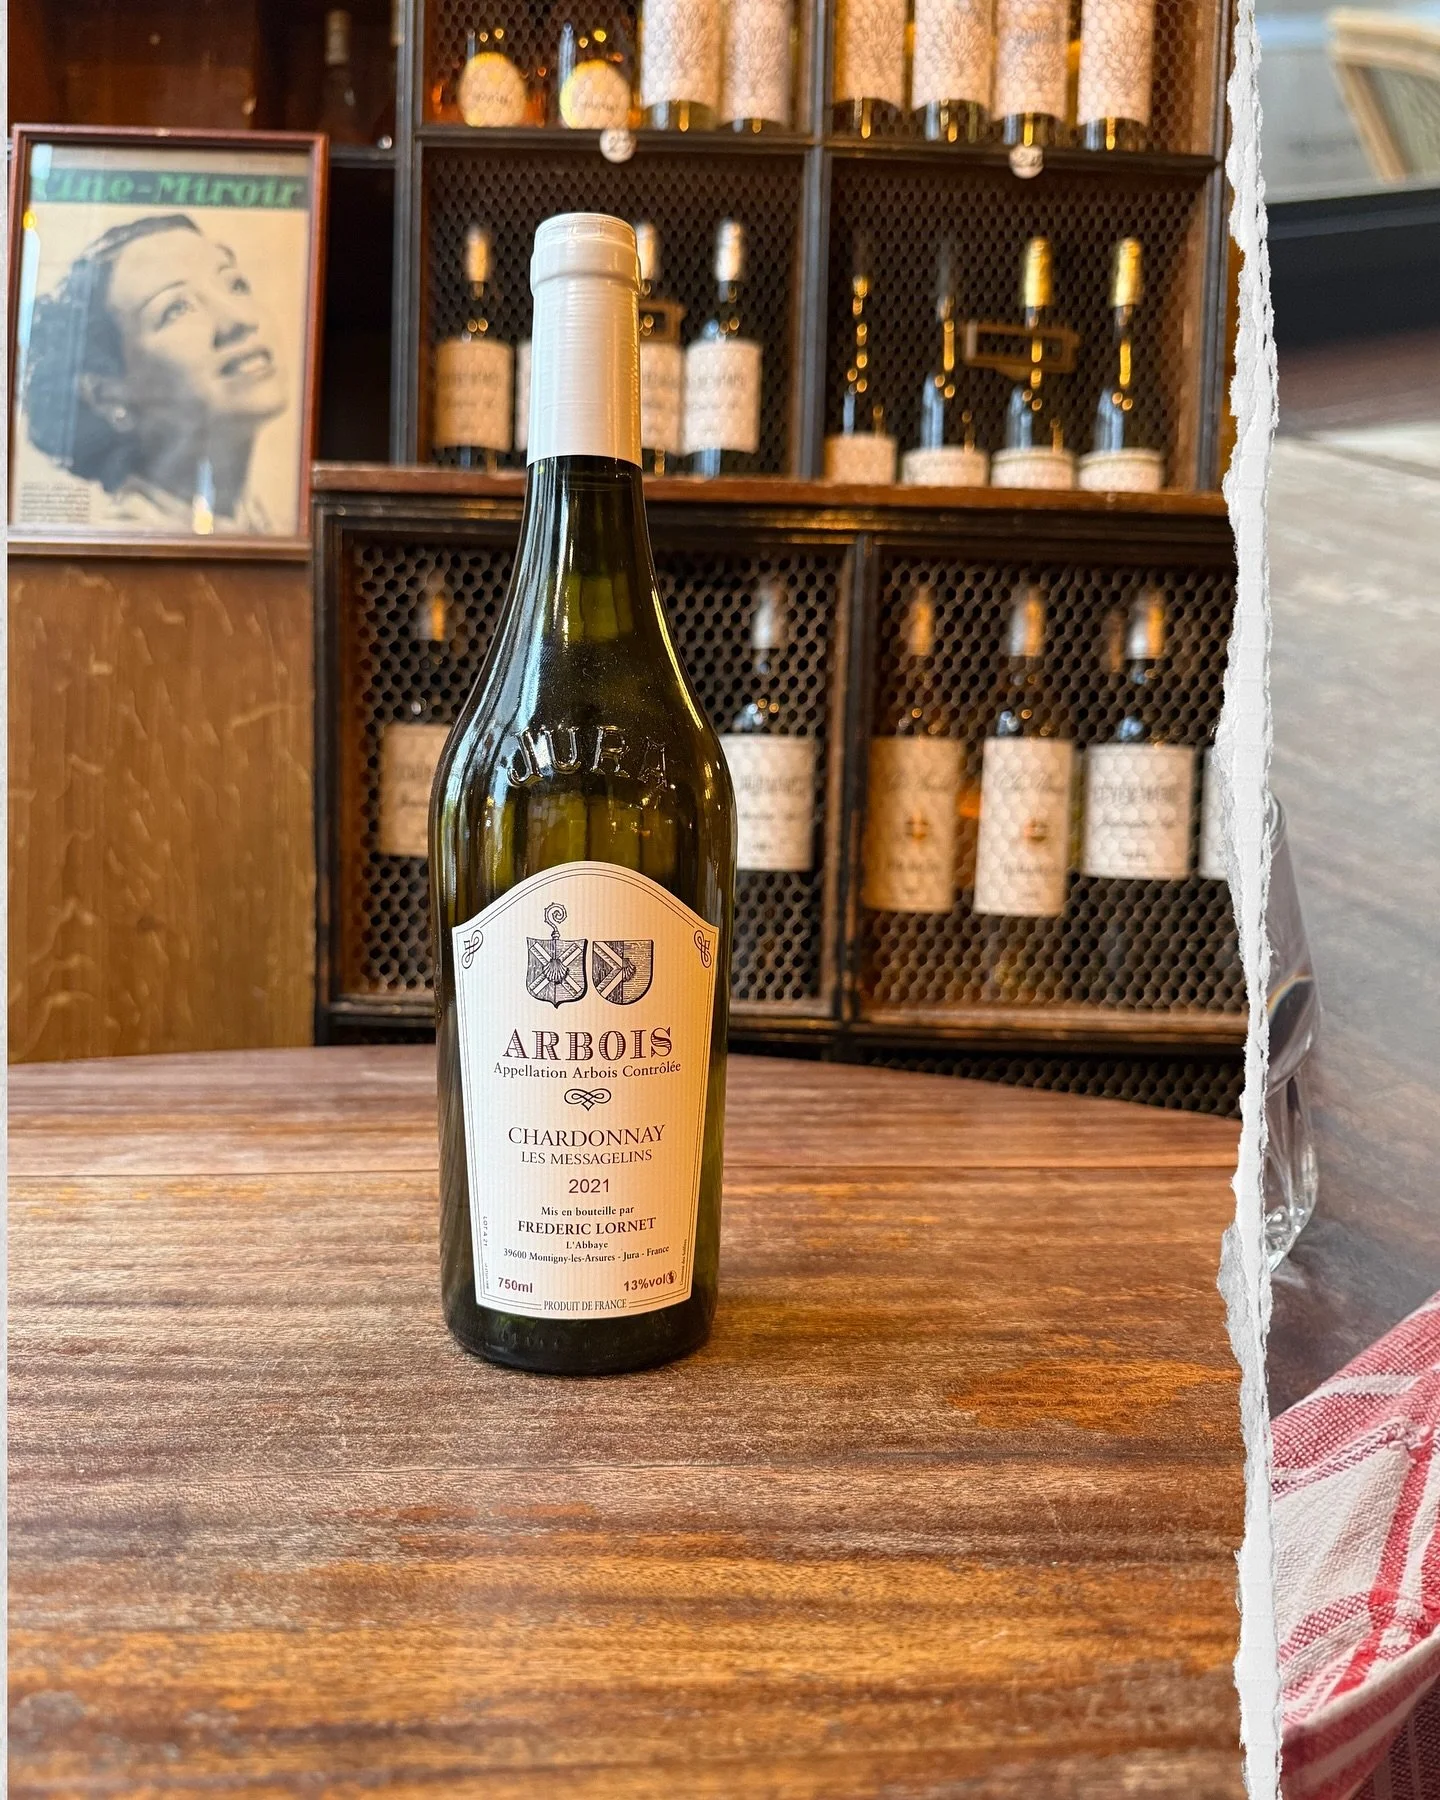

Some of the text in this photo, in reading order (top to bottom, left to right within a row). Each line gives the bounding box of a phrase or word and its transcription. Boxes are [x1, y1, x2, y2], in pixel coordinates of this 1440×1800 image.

[507, 726, 668, 793] JURA
[502, 1027, 672, 1061] ARBOIS
[494, 1060, 681, 1079] Appellation Arbois Contrôlée
[508, 1124, 665, 1147] CHARDONNAY
[521, 1149, 653, 1165] LES MESSAGELINS
[568, 1178, 610, 1194] 2021
[541, 1206, 559, 1216] Mis
[575, 1206, 617, 1216] bouteille
[619, 1206, 635, 1217] par
[518, 1217, 657, 1235] FREDERIC LORNET
[566, 1240, 609, 1250] L'Abbaye
[503, 1247, 527, 1259] 39600
[529, 1251, 616, 1264] Montigny-les-Arsures
[622, 1251, 640, 1262] Jura
[646, 1246, 670, 1257] France
[498, 1277, 533, 1293] 750ml
[624, 1273, 666, 1291] 13%vol
[543, 1298, 627, 1312] PRODUIT DE FRANCE
